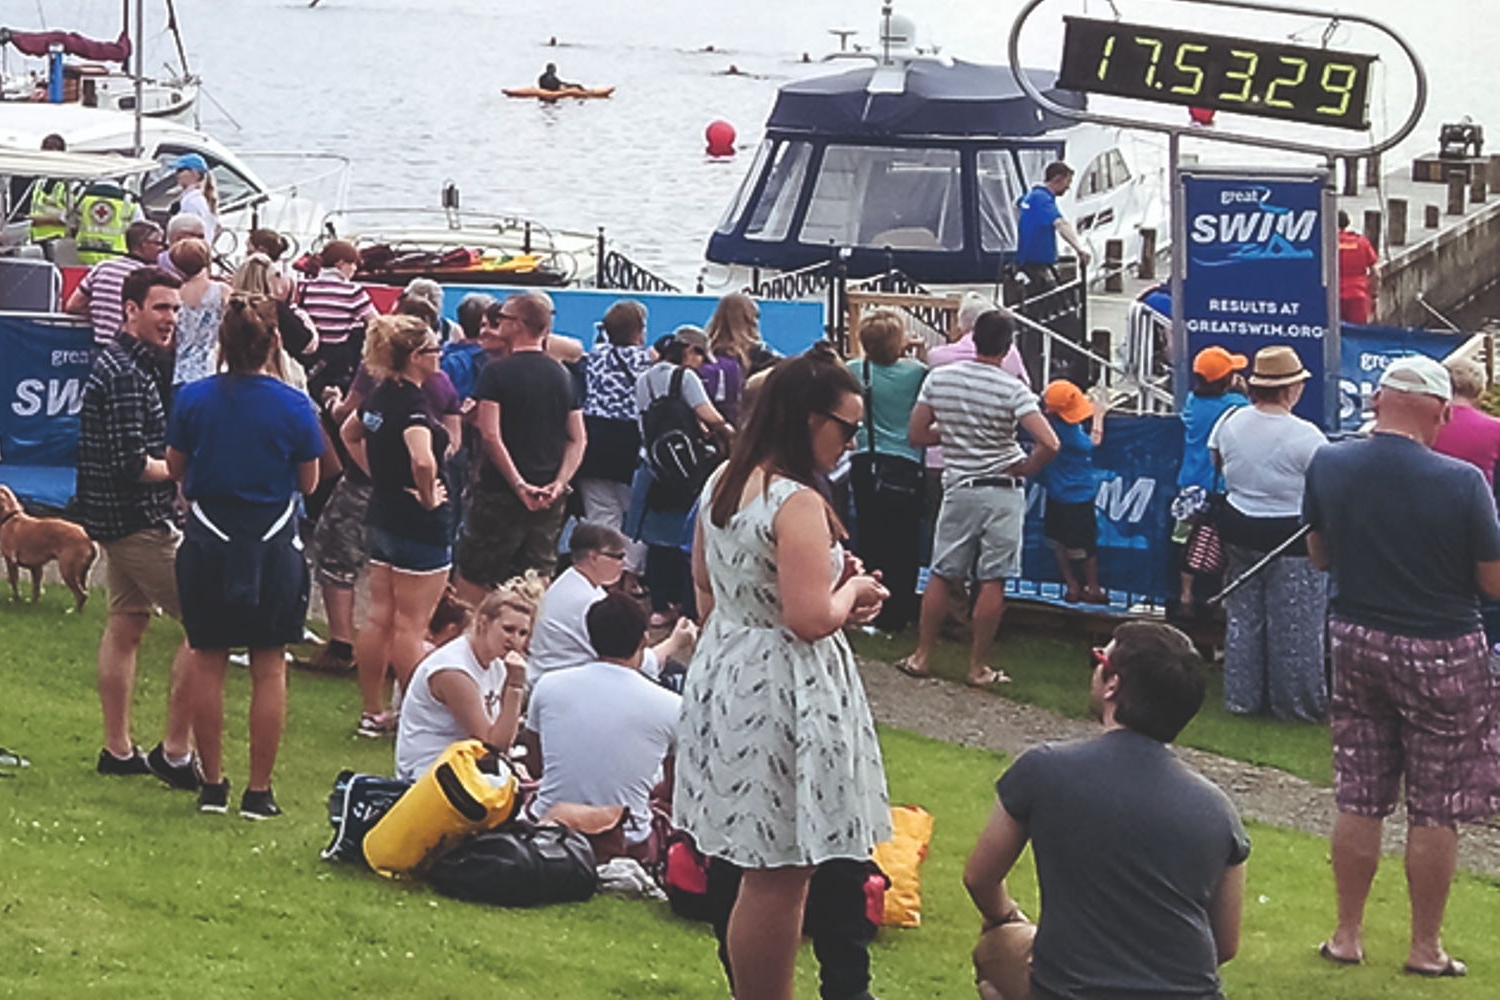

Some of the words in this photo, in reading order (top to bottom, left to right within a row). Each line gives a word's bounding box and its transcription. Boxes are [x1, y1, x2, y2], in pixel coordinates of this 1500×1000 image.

[1221, 190, 1258, 204] great
[1191, 210, 1317, 243] SWIM
[1209, 298, 1278, 314] RESULTS
[1280, 302, 1300, 315] AT
[1187, 319, 1323, 339] GREATSWIM.ORG
[52, 350, 89, 366] grea
[11, 378, 84, 416] SW
